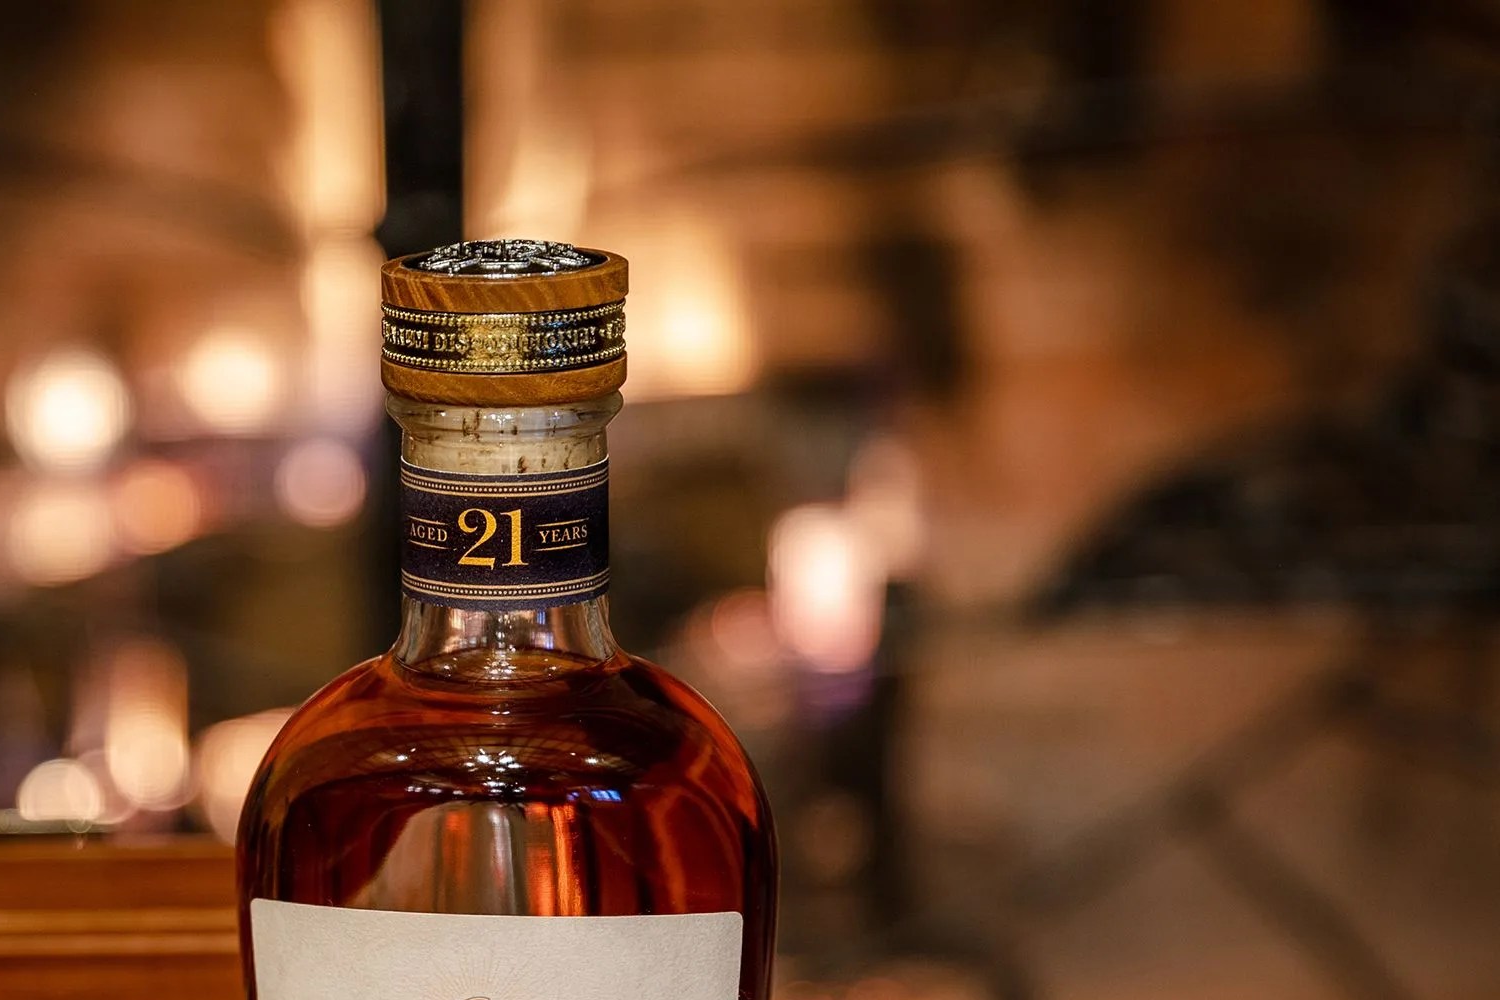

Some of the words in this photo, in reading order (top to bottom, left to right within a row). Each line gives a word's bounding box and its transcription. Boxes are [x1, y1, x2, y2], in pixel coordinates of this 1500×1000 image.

[409, 523, 448, 543] AGED
[456, 507, 530, 570] 21
[539, 525, 588, 545] YEARS
